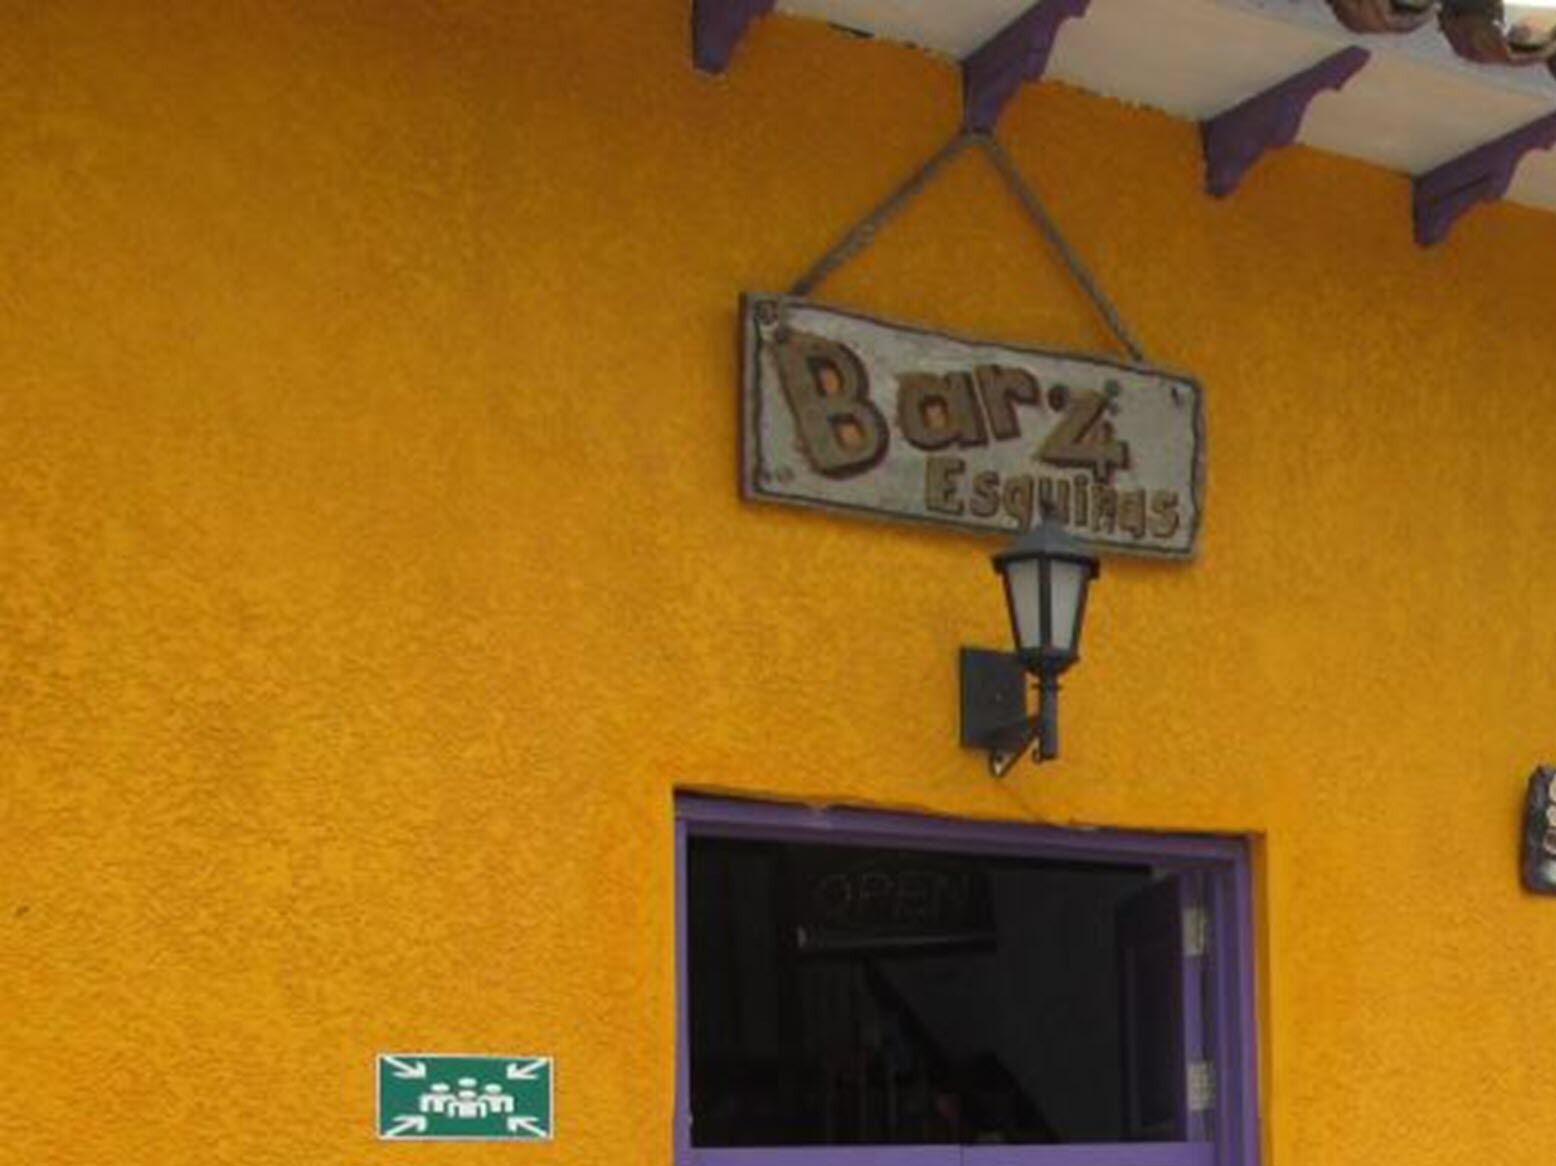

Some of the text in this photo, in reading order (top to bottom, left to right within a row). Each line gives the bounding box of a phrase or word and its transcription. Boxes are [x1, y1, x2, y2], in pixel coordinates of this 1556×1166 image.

[772, 328, 1134, 484] Bar 4
[924, 453, 1182, 540] Esquinas
